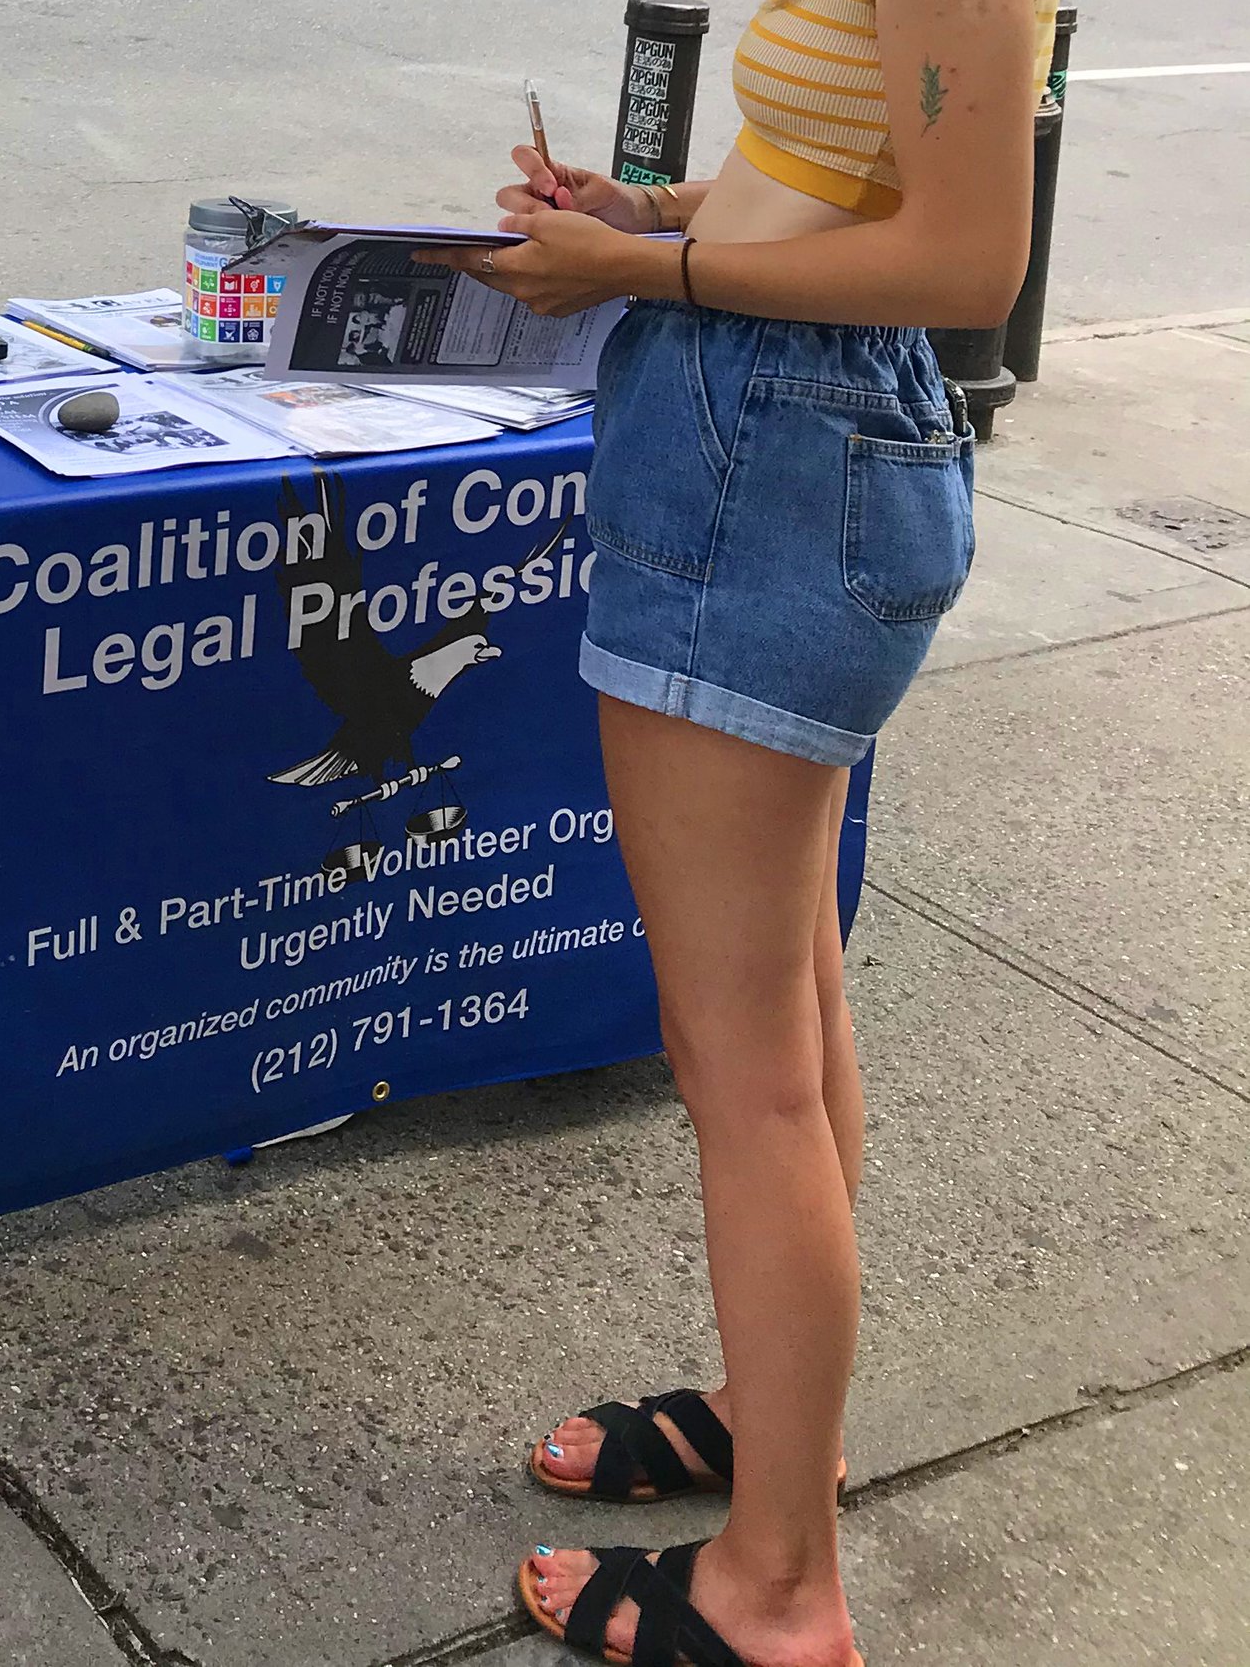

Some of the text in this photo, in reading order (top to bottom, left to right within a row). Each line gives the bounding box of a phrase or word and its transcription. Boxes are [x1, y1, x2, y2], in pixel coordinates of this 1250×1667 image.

[636, 39, 674, 59] ZIPGUN
[630, 67, 668, 87] ZIPGUN
[630, 98, 669, 118] ZIPGUN
[625, 127, 662, 147] ZIPGUN
[313, 283, 330, 307] NOT
[328, 289, 345, 313] NOT
[311, 307, 323, 318] IF
[326, 314, 338, 325] IF
[356, 479, 428, 551] of
[43, 594, 257, 694] Legal
[28, 808, 613, 967] Full & Part-Time Volunteer Org
[240, 864, 554, 970] Urgently Needed
[56, 1045, 99, 1077] An
[108, 999, 260, 1061] organized
[266, 952, 418, 1020] community
[425, 947, 449, 974] is
[458, 941, 504, 969] the
[512, 918, 625, 959] ultimate
[251, 988, 530, 1094] (212) 791-1364
